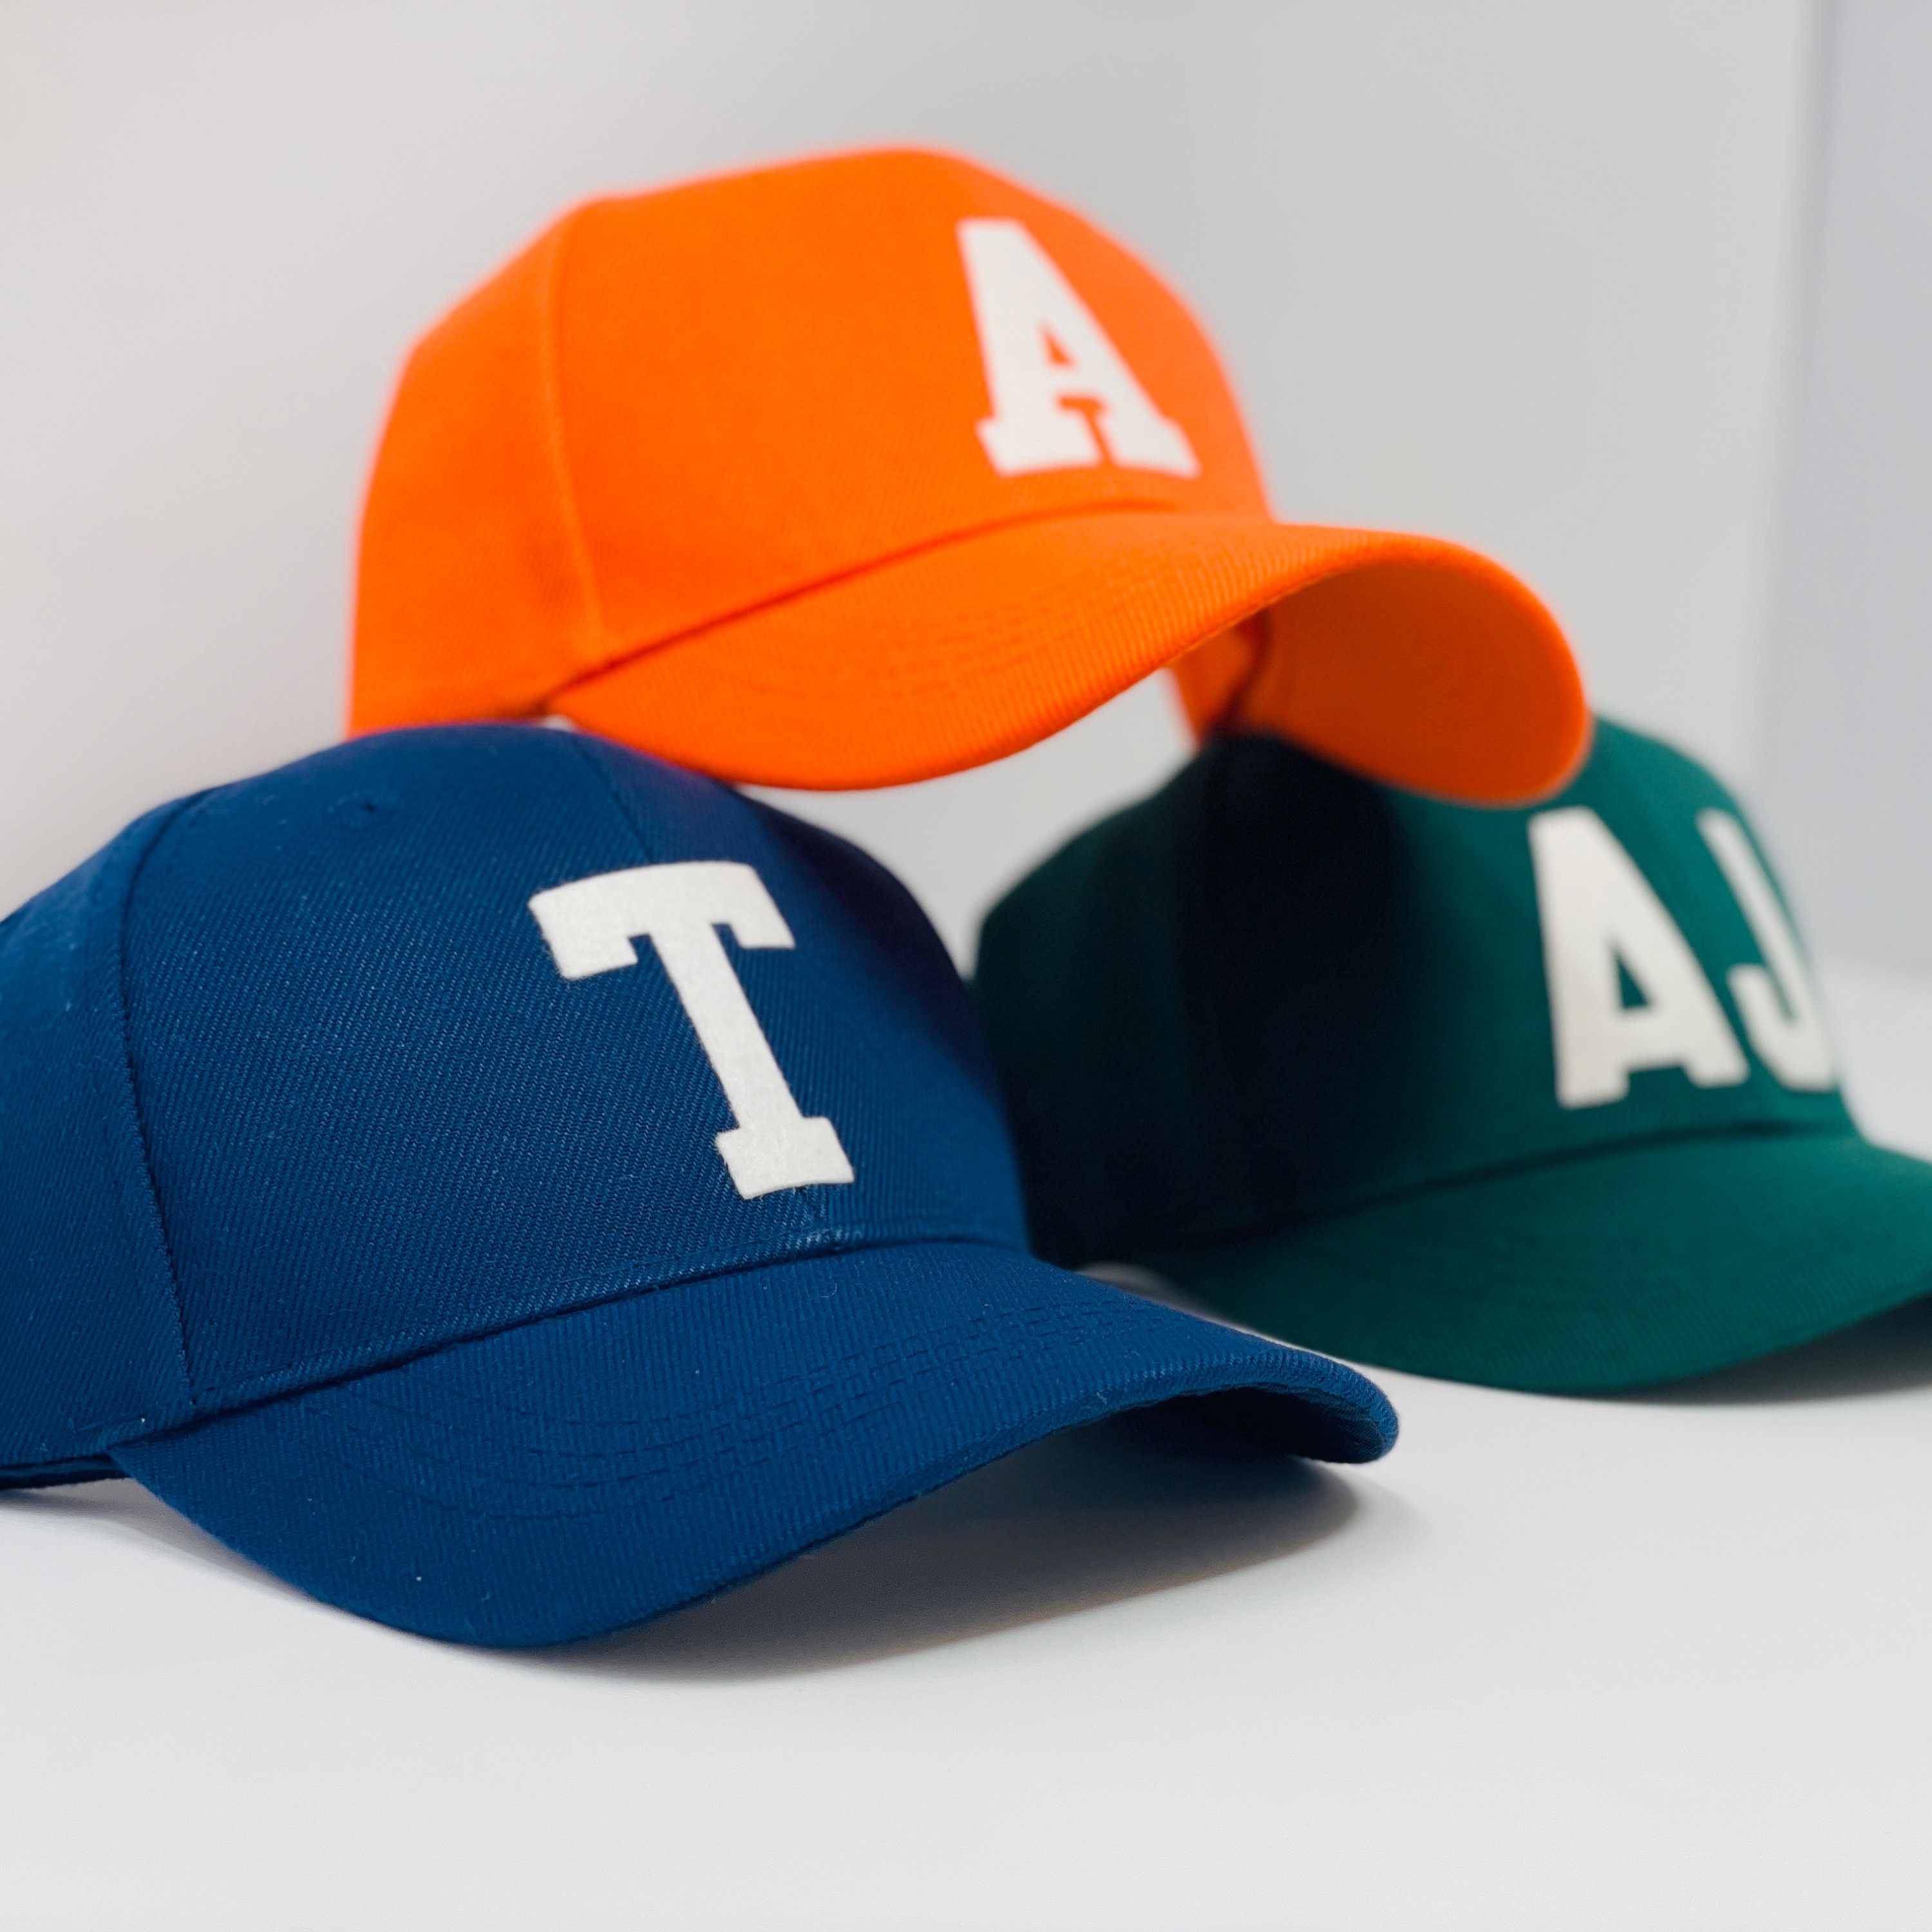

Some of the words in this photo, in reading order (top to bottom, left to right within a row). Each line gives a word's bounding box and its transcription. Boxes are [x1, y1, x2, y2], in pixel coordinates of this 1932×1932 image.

[957, 218, 1200, 478] A
[528, 861, 855, 1200] T
[1528, 807, 1838, 1108] AJ
